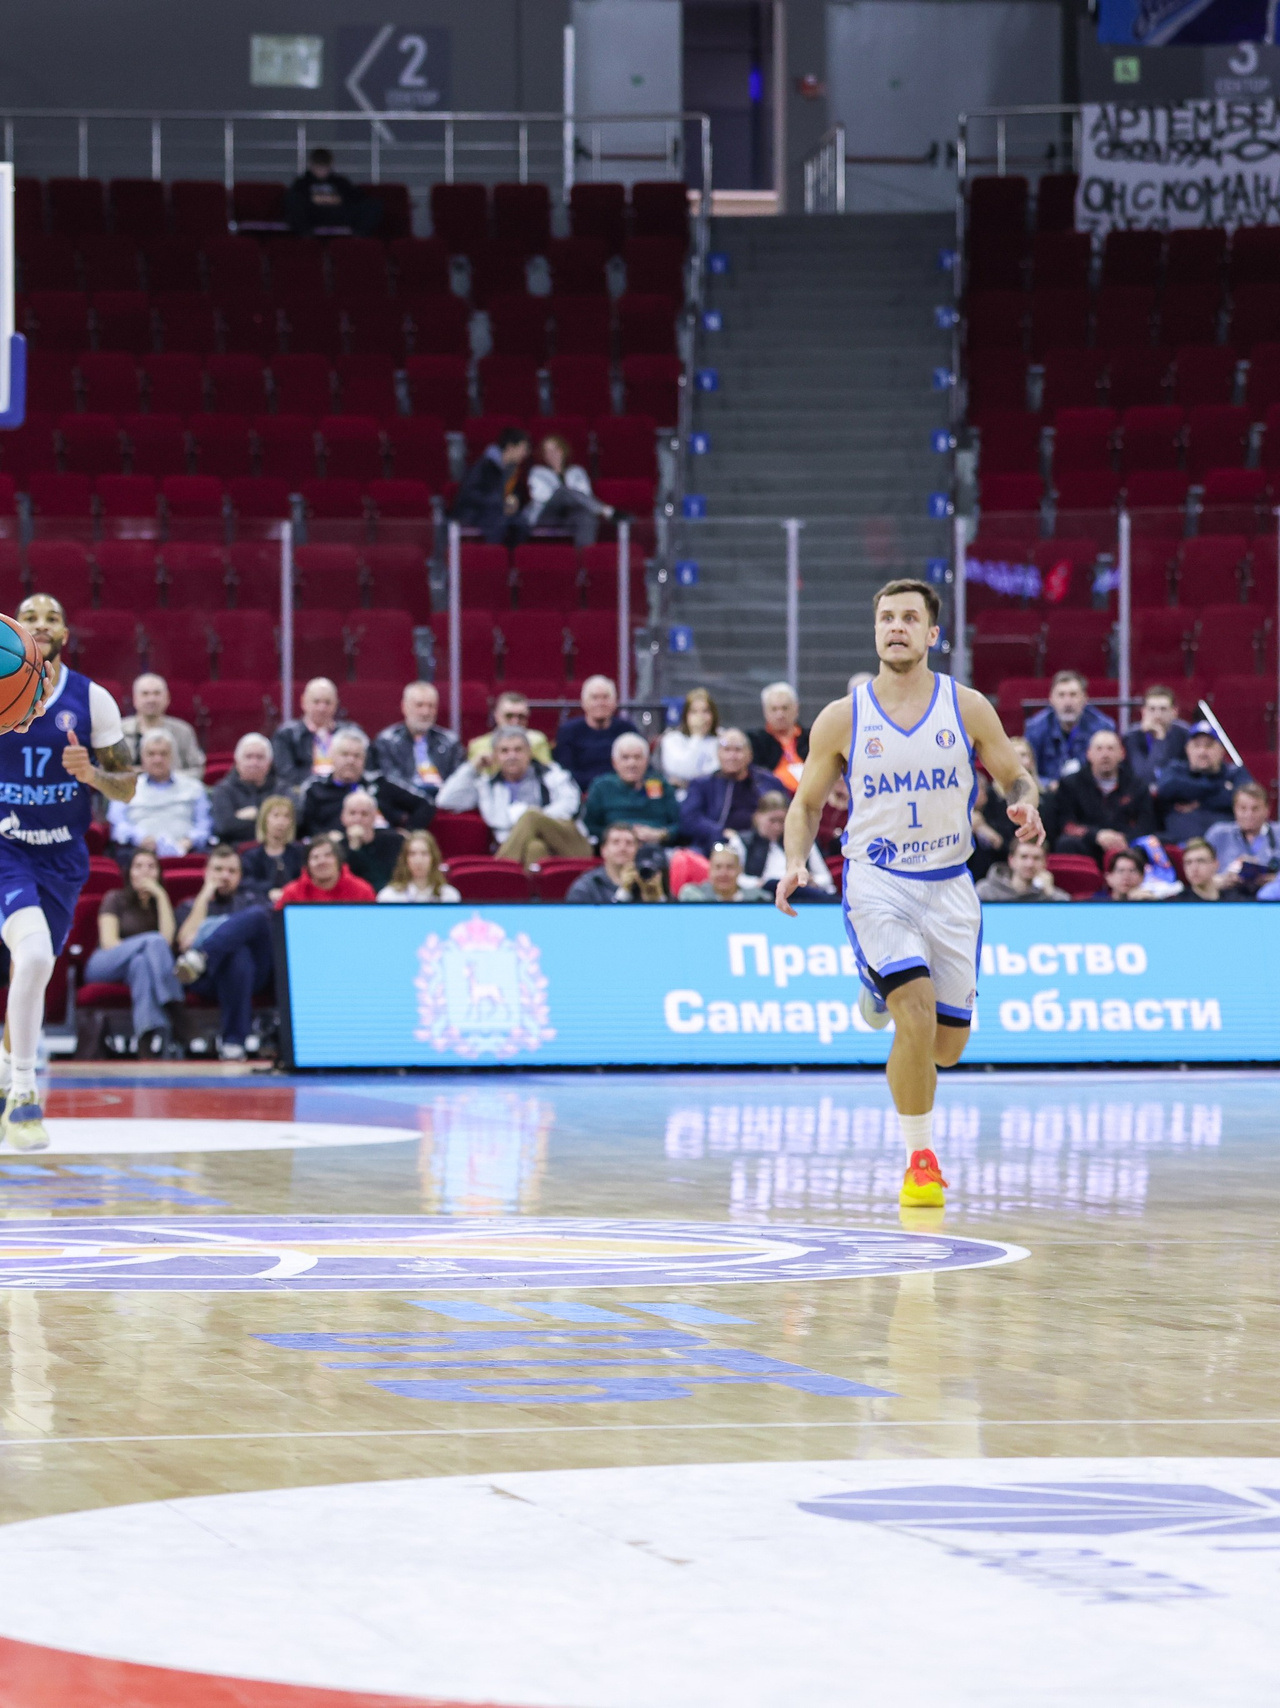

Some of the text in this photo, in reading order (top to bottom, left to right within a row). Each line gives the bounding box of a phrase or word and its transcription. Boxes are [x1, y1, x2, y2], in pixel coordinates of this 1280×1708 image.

[397, 34, 428, 87] 2
[21, 746, 53, 778] 17
[863, 766, 959, 798] SAMARA
[907, 801, 923, 829] 1
[902, 833, 960, 853] РОССЕТИ
[728, 933, 1149, 987] Правьство
[663, 989, 1223, 1044] Самарс области
